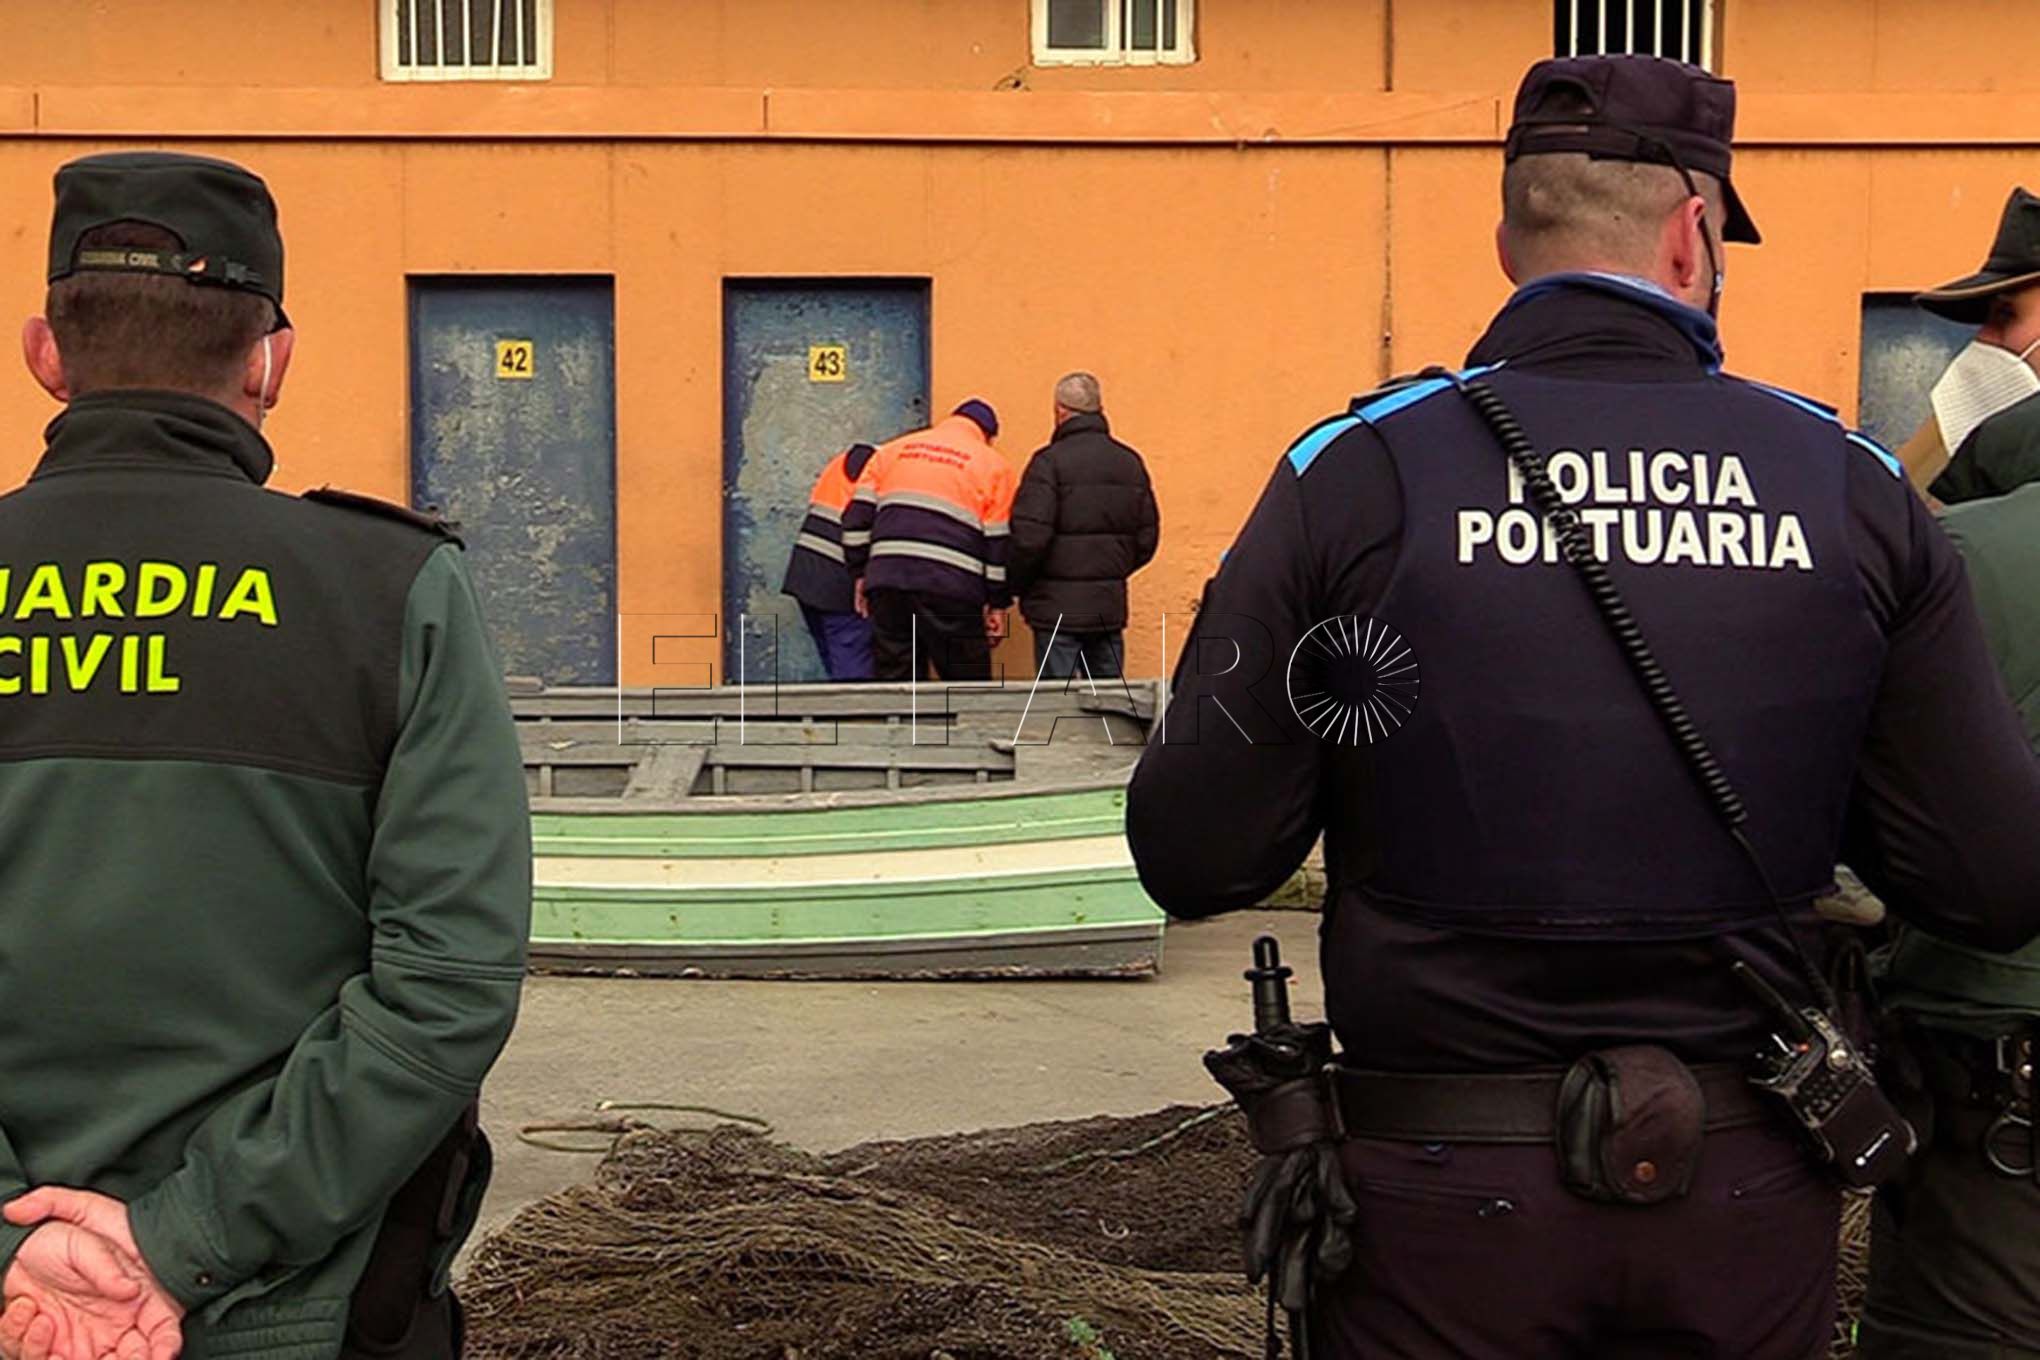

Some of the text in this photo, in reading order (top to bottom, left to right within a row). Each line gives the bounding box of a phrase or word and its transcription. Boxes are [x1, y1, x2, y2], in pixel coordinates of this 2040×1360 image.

[502, 347, 527, 372] 42
[815, 351, 840, 376] 43
[0, 562, 278, 625] ARDIA
